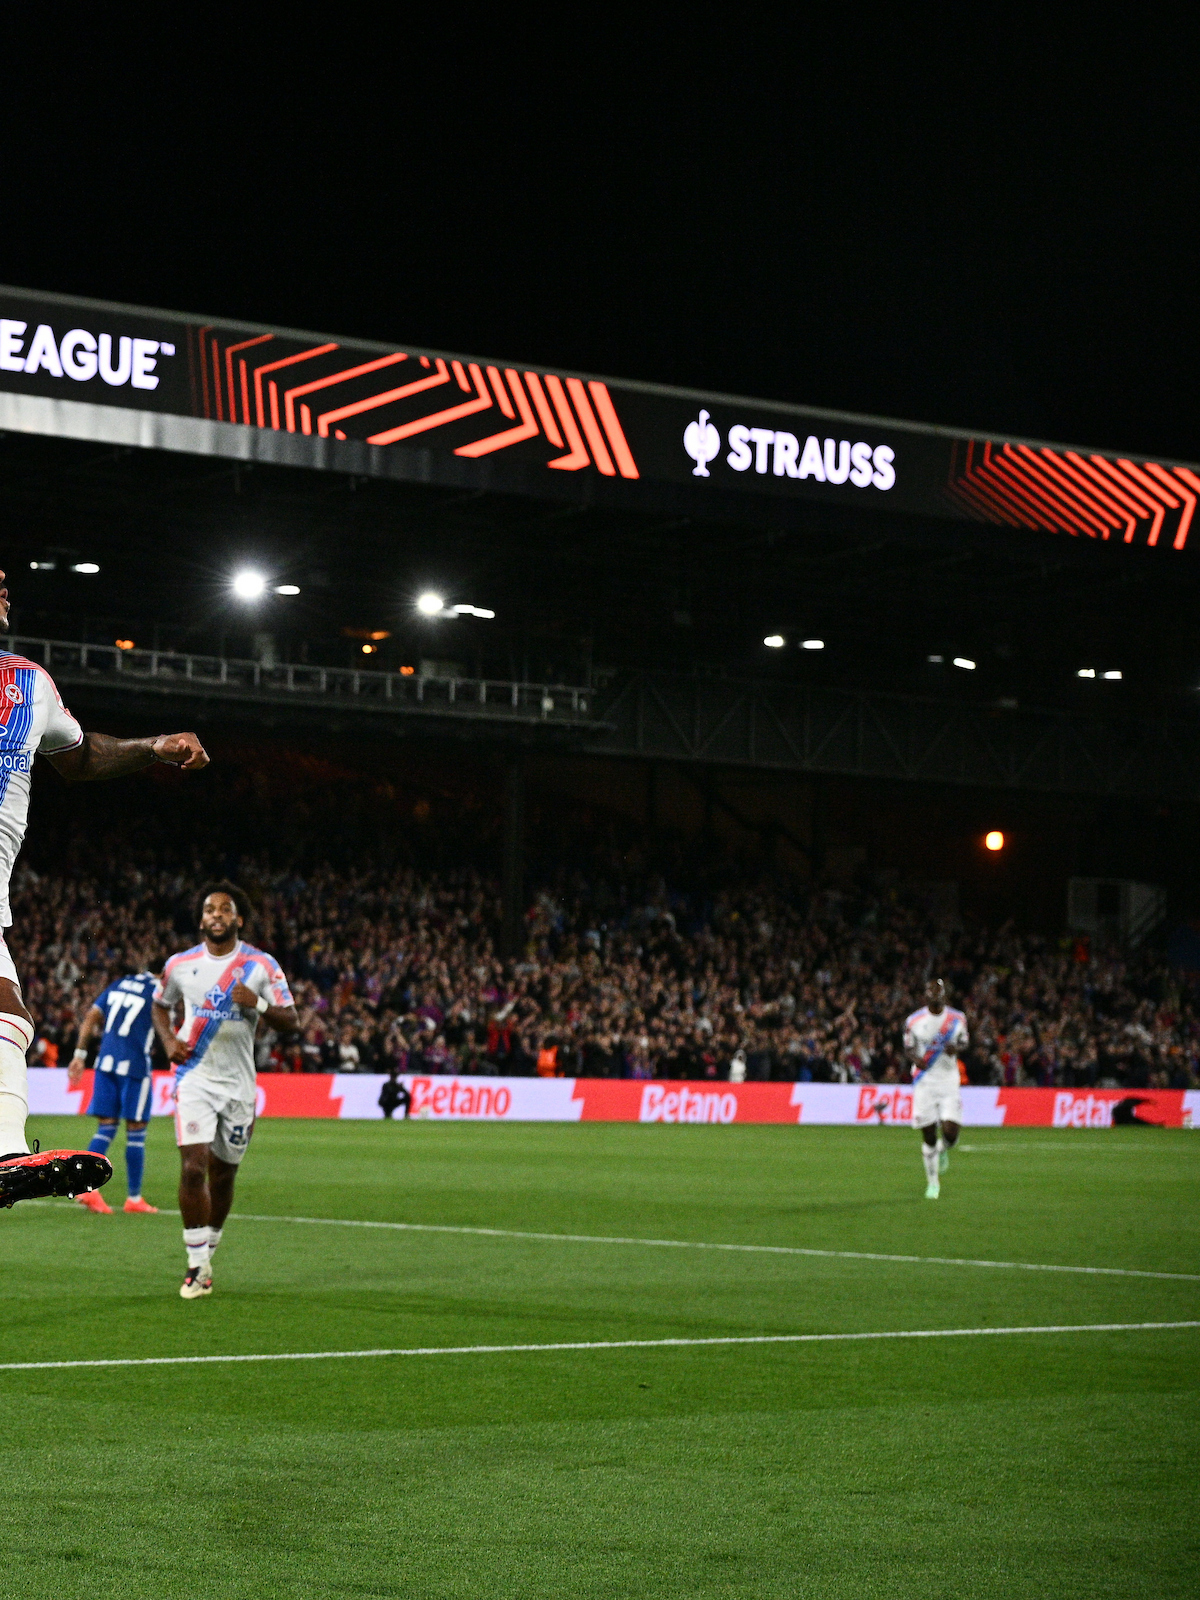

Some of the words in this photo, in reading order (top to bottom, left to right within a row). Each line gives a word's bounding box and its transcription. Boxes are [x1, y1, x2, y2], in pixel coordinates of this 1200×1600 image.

[726, 424, 897, 491] STRAUSS
[105, 990, 146, 1037] 77
[409, 1077, 512, 1116] Betano
[639, 1084, 737, 1124] Betano
